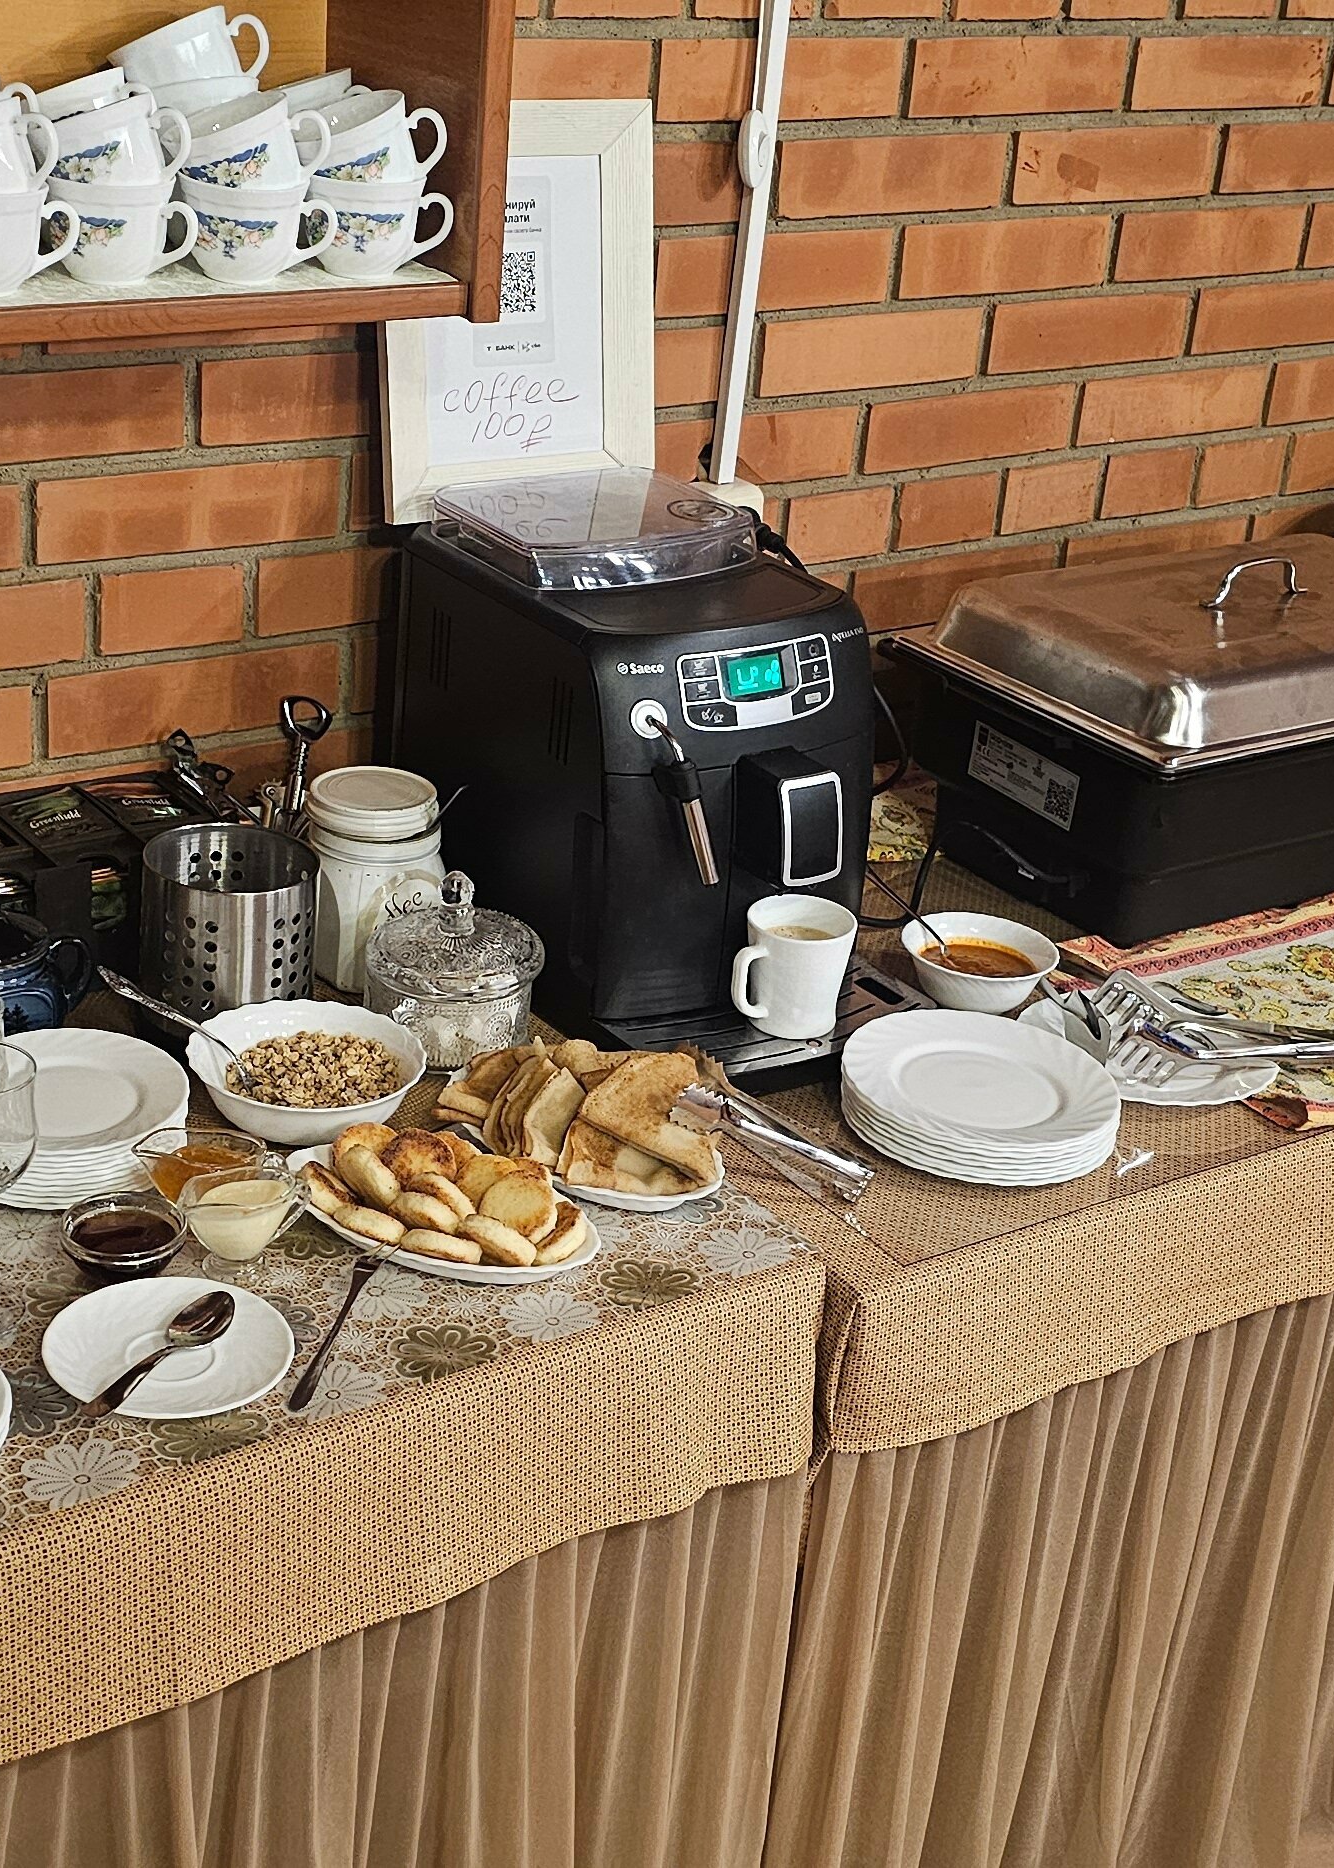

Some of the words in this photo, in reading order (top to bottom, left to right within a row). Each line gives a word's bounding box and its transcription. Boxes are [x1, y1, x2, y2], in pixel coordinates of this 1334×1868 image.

[505, 198, 536, 211] нируй
[630, 662, 665, 675] Saeco
[29, 808, 82, 829] Greenfield
[384, 891, 423, 919] ffee
